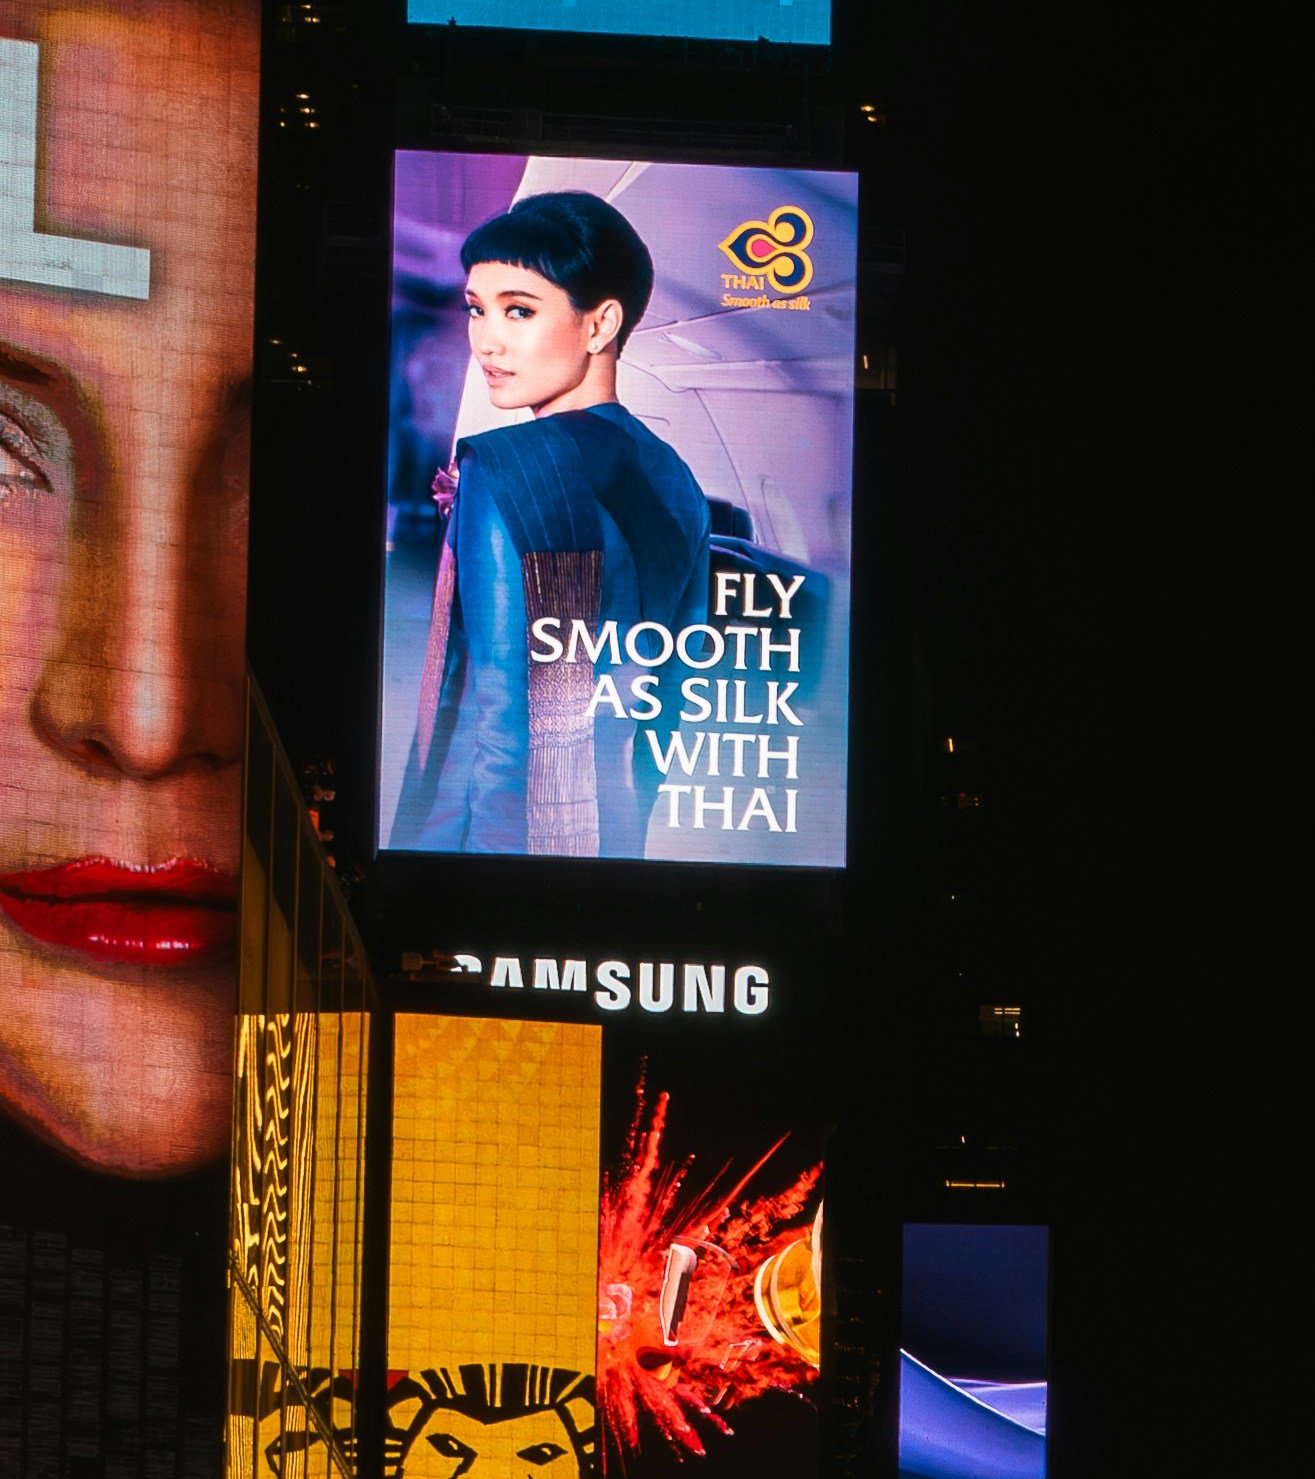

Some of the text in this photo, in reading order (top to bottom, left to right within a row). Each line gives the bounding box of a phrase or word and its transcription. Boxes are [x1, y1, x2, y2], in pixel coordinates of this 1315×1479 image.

[720, 273, 765, 290] THAI
[721, 293, 811, 311] Smooth as silk
[714, 571, 806, 619] FLY
[530, 616, 801, 672] SMOOTH
[583, 673, 804, 726] AS SILK
[645, 729, 800, 779] WITH
[657, 783, 798, 833] THAI
